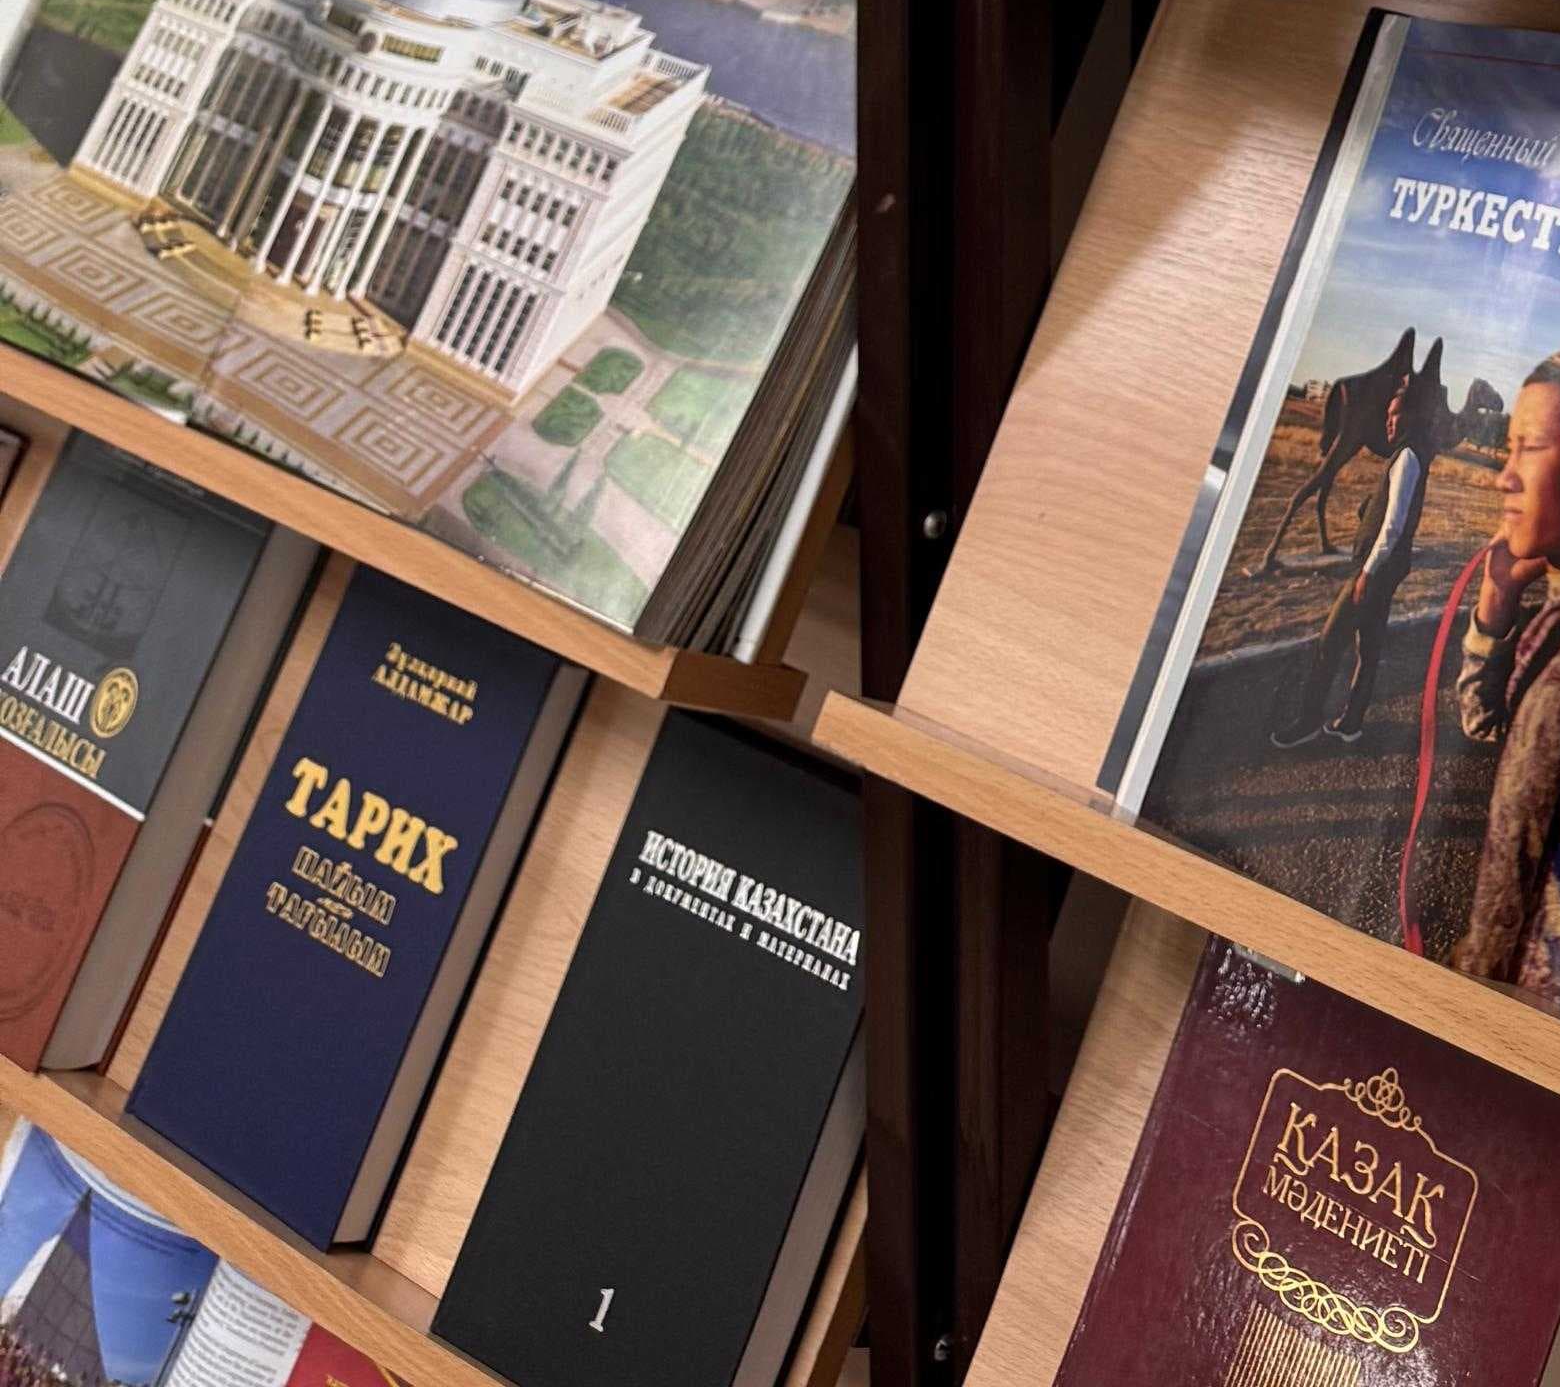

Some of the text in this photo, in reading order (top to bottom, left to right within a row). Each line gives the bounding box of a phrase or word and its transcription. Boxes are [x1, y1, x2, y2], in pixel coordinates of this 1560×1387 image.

[1412, 107, 1559, 166] Священный
[0, 645, 96, 725] АЛАШ
[285, 757, 458, 894] ТАРИХ
[629, 867, 851, 991] В ДОКУМЕНТАХ И МАТЕРИАЛАХ
[638, 830, 861, 966] ИСТОРИЯ КАЗАХСТАНА
[1263, 1165, 1430, 1284] МӘДЕНИЕТІ
[1273, 1102, 1445, 1249] ҚАЗАҚ
[589, 1288, 614, 1332] 1
